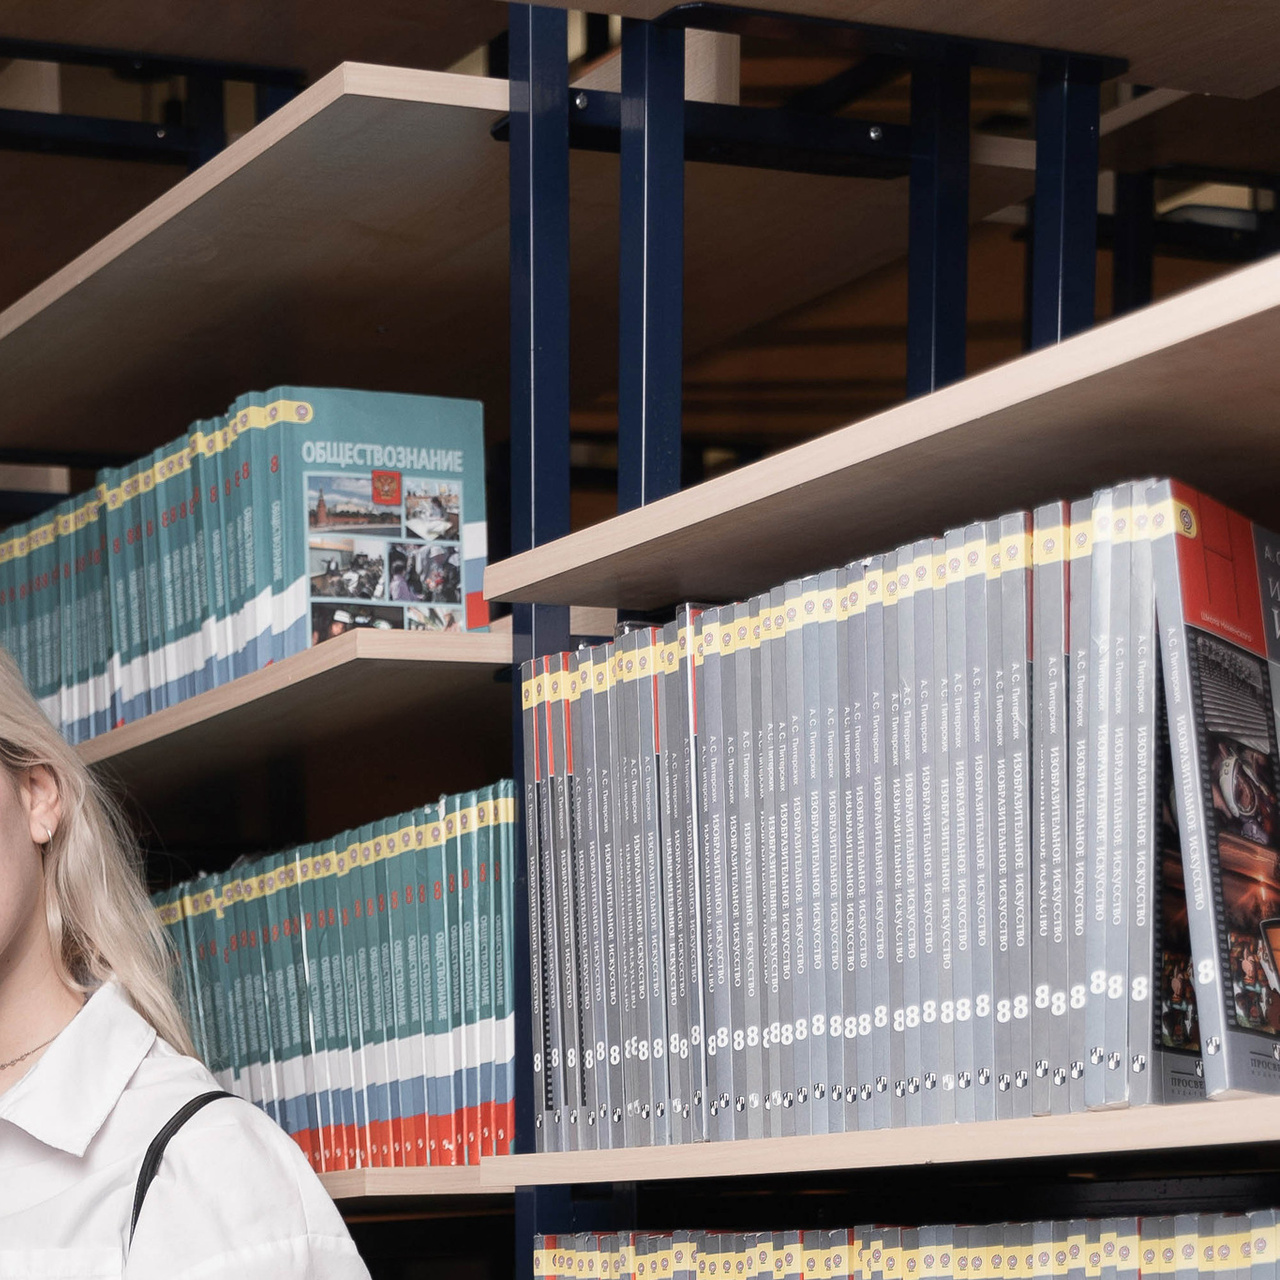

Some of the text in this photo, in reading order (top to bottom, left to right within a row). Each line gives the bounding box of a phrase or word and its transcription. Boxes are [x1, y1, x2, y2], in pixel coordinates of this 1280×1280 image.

[270, 455, 279, 473] 8
[301, 441, 464, 473] ОБЩЕСТВОЗНАНИЕ
[920, 703, 929, 754] Питерских
[973, 691, 981, 743] Питерских
[921, 765, 932, 879] ИЗОБРАЗИТЕЛЬНОЕ
[974, 754, 985, 871] ИЗОБРАЗИТЕЛЬНОЕ
[1169, 651, 1182, 704] Питерских
[1176, 714, 1196, 833] ИЗОБРАЗИТЕЛЬНОЕ
[1188, 836, 1205, 911] ИСКУССТВО
[1197, 958, 1215, 985] 8
[434, 880, 442, 900] 8
[479, 863, 487, 882] 8
[729, 815, 739, 919] ИЗОБРАЗИТЕЛЬНОЕ
[923, 882, 933, 954] ИСКУССТВО
[976, 874, 987, 946] ИСКУССТВО
[435, 931, 448, 1022] ОБЩЕСТВОЗНАНИЕ
[732, 921, 741, 987] ИСКУССТВО
[922, 1000, 937, 1023] 8
[975, 994, 990, 1017] 8
[733, 1029, 745, 1051] 8
